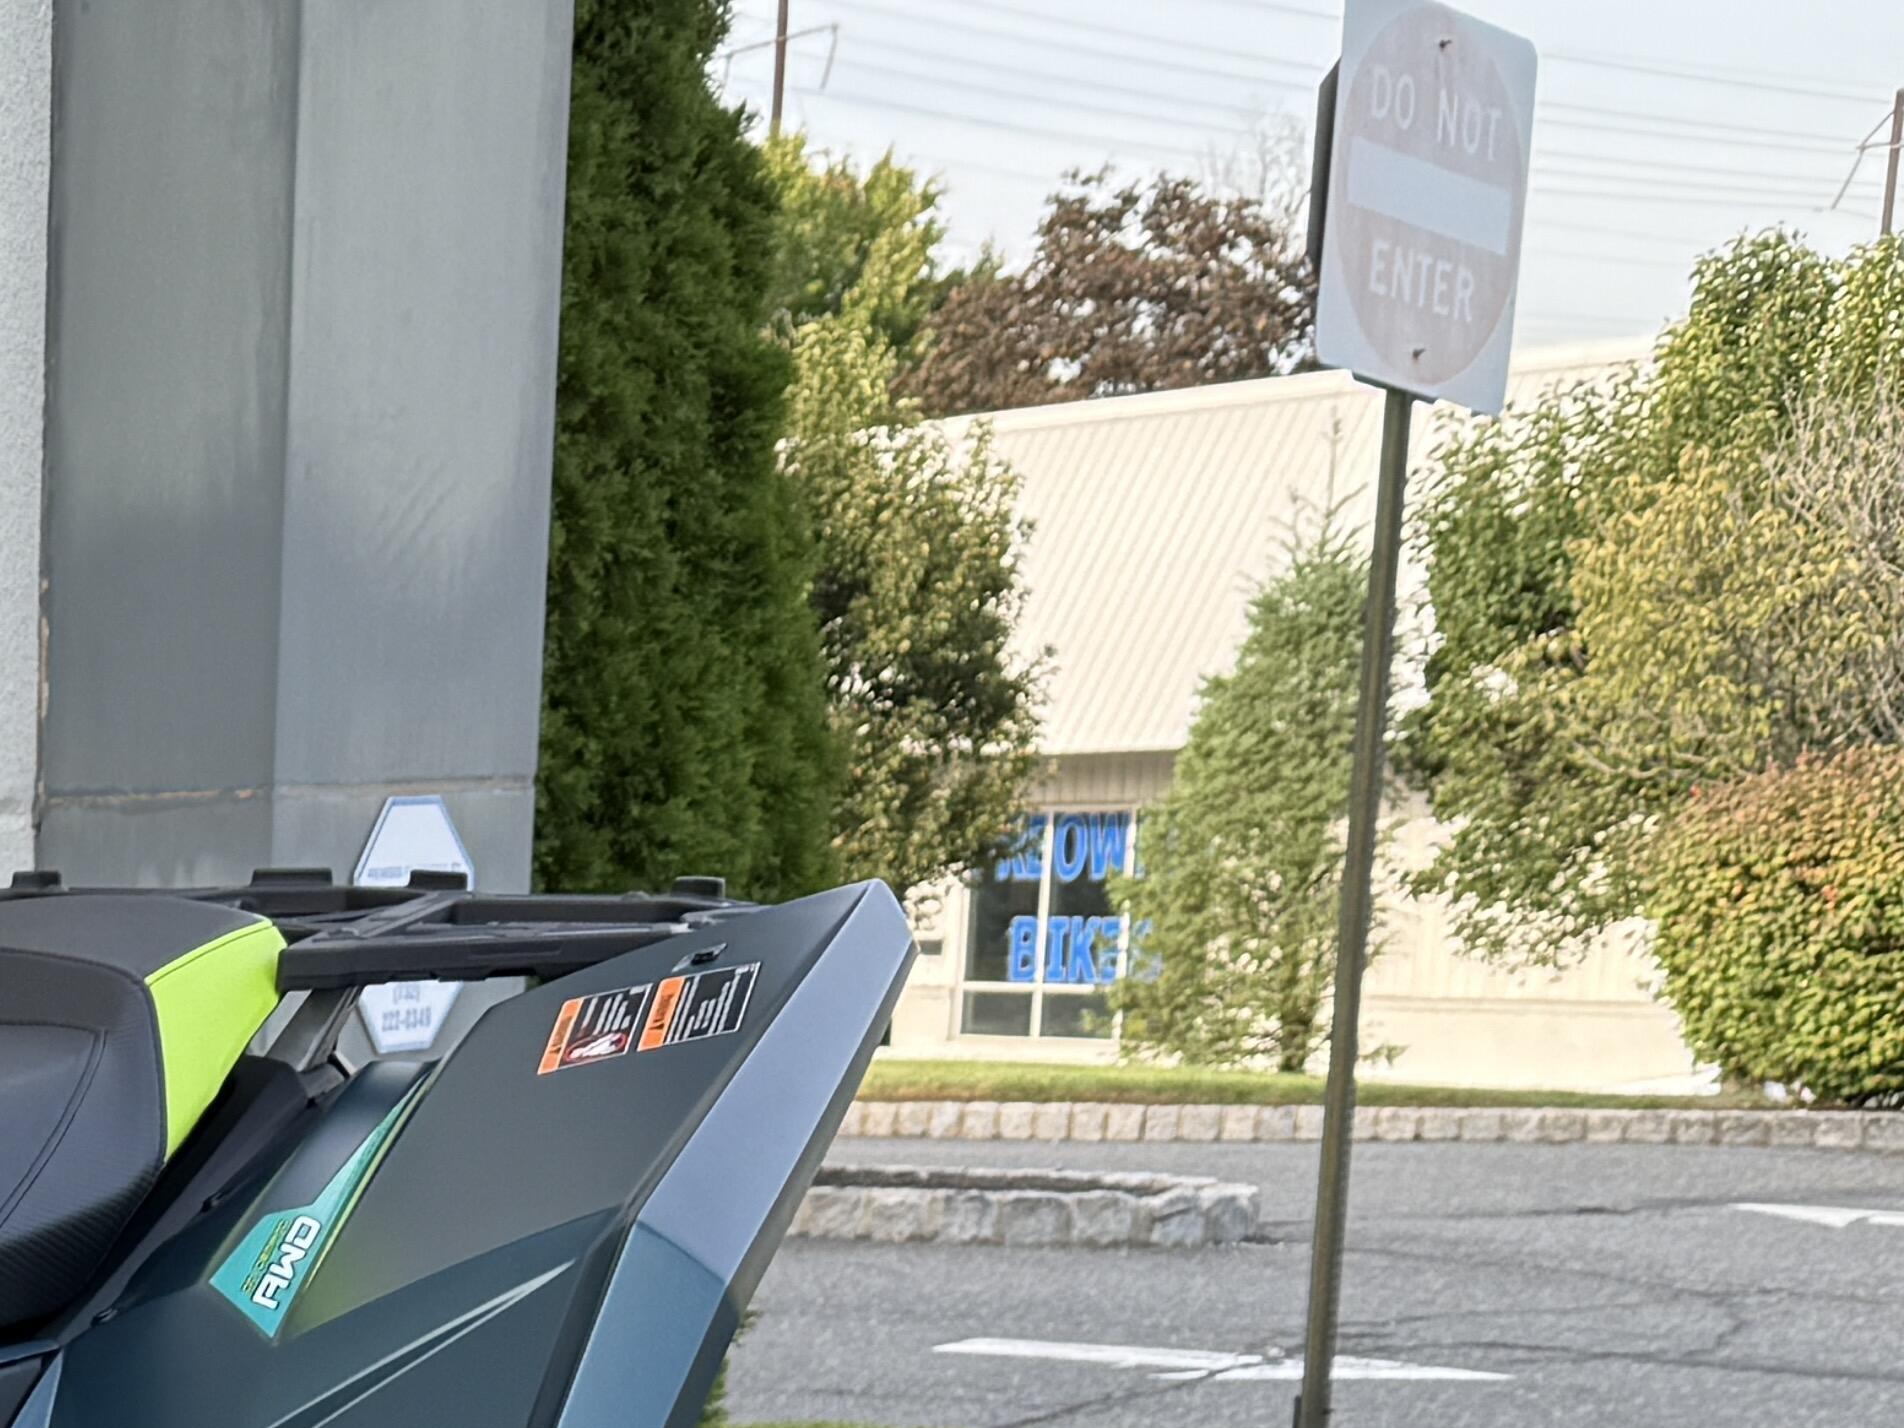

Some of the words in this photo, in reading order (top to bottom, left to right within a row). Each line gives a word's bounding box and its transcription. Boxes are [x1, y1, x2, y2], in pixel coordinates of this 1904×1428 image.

[1369, 63, 1416, 130] DO
[1436, 87, 1503, 162] NOT
[1367, 238, 1476, 323] ENTER
[251, 1215, 322, 1311] AWD
